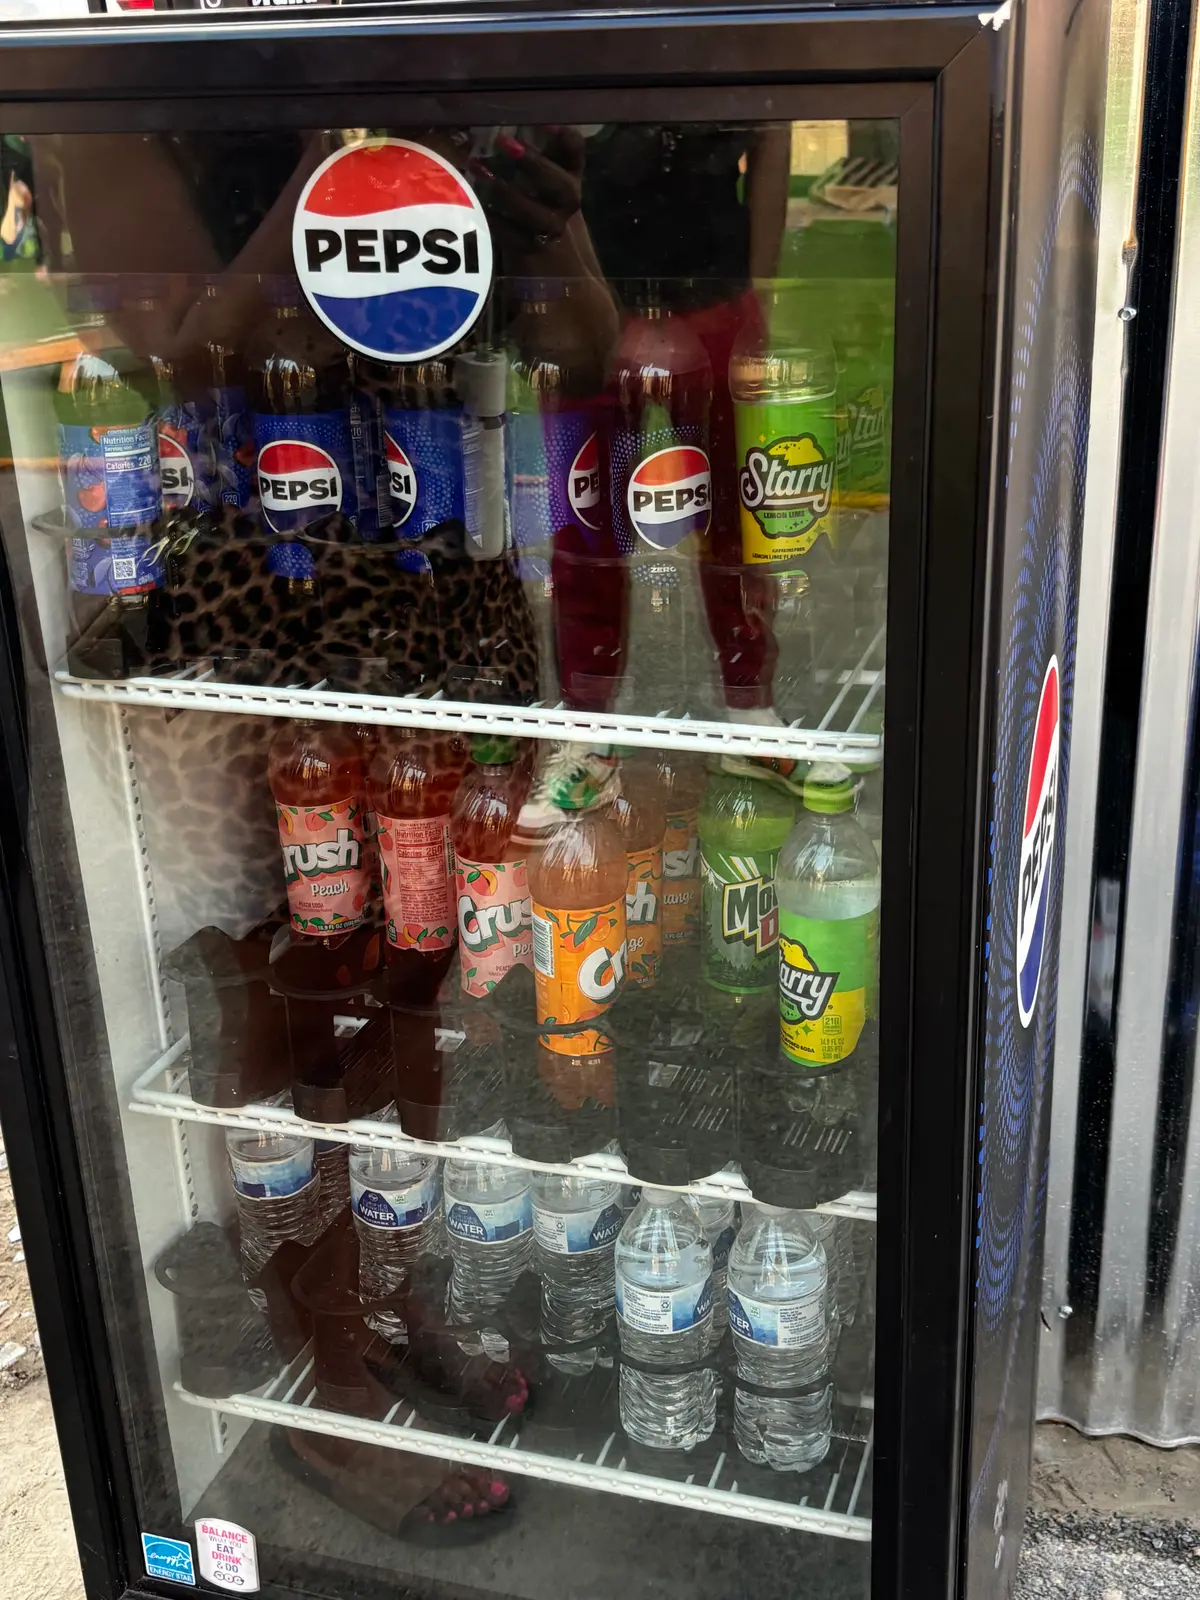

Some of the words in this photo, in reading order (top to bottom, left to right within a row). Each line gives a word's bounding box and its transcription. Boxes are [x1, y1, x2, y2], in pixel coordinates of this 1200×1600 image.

[305, 228, 480, 275] PEPSI
[103, 436, 135, 445] Nutrition
[105, 461, 135, 471] Calories
[259, 476, 337, 501] PEPSI
[741, 452, 835, 513] Starry
[397, 830, 424, 838] Nutrition
[284, 829, 359, 877] rush
[398, 849, 423, 858] Calories
[311, 879, 350, 897] Peach
[459, 896, 532, 946] Crus
[780, 950, 833, 1016] arry
[825, 1017, 840, 1025] 210
[359, 1203, 395, 1221] WATER
[448, 1216, 484, 1235] WATER
[730, 1310, 751, 1332] TER
[201, 1524, 248, 1544] BALANCE
[209, 1535, 227, 1543] WHAT
[229, 1540, 242, 1549] YOU
[211, 1550, 242, 1566] DRINK
[216, 1543, 234, 1555] EAT
[149, 1566, 175, 1579] ENERGY
[175, 1573, 193, 1583] STAR
[216, 1560, 223, 1570] &
[225, 1562, 239, 1573] DO
